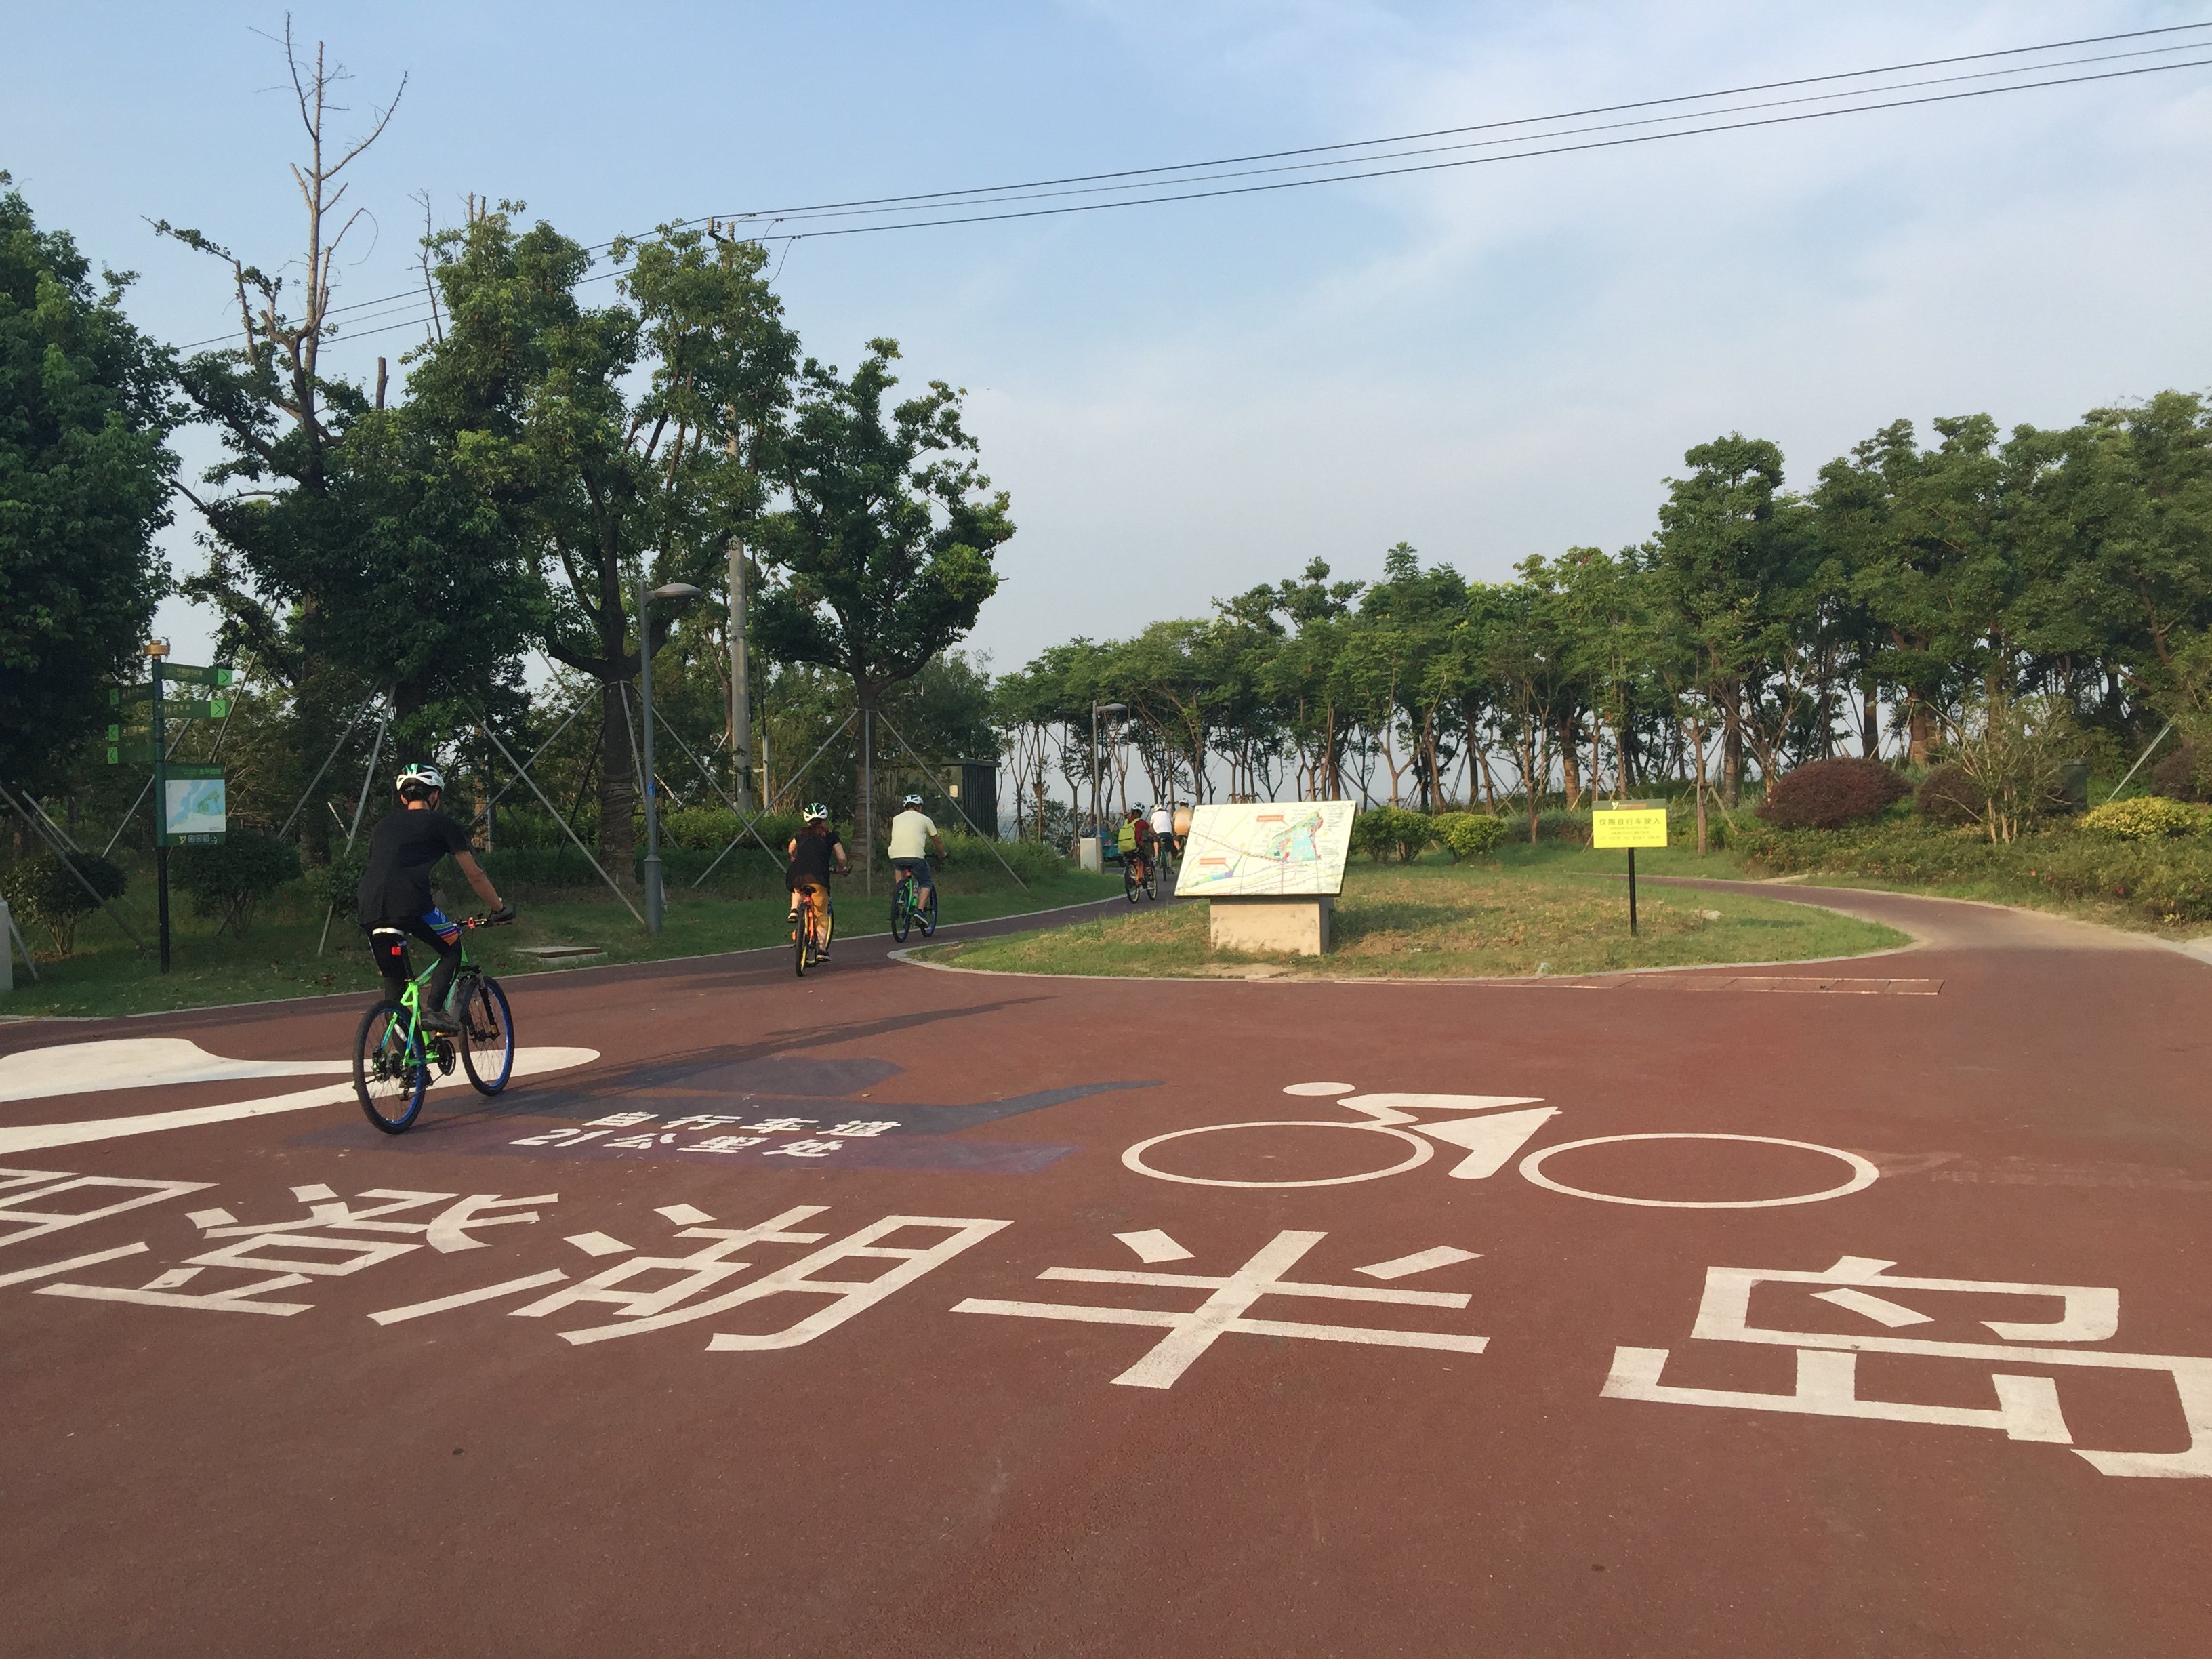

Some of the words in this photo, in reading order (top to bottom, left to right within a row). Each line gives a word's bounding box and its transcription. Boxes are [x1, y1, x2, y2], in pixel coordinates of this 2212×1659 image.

[581, 1111, 902, 1137] 自行车道
[508, 1128, 844, 1157] 21公里处
